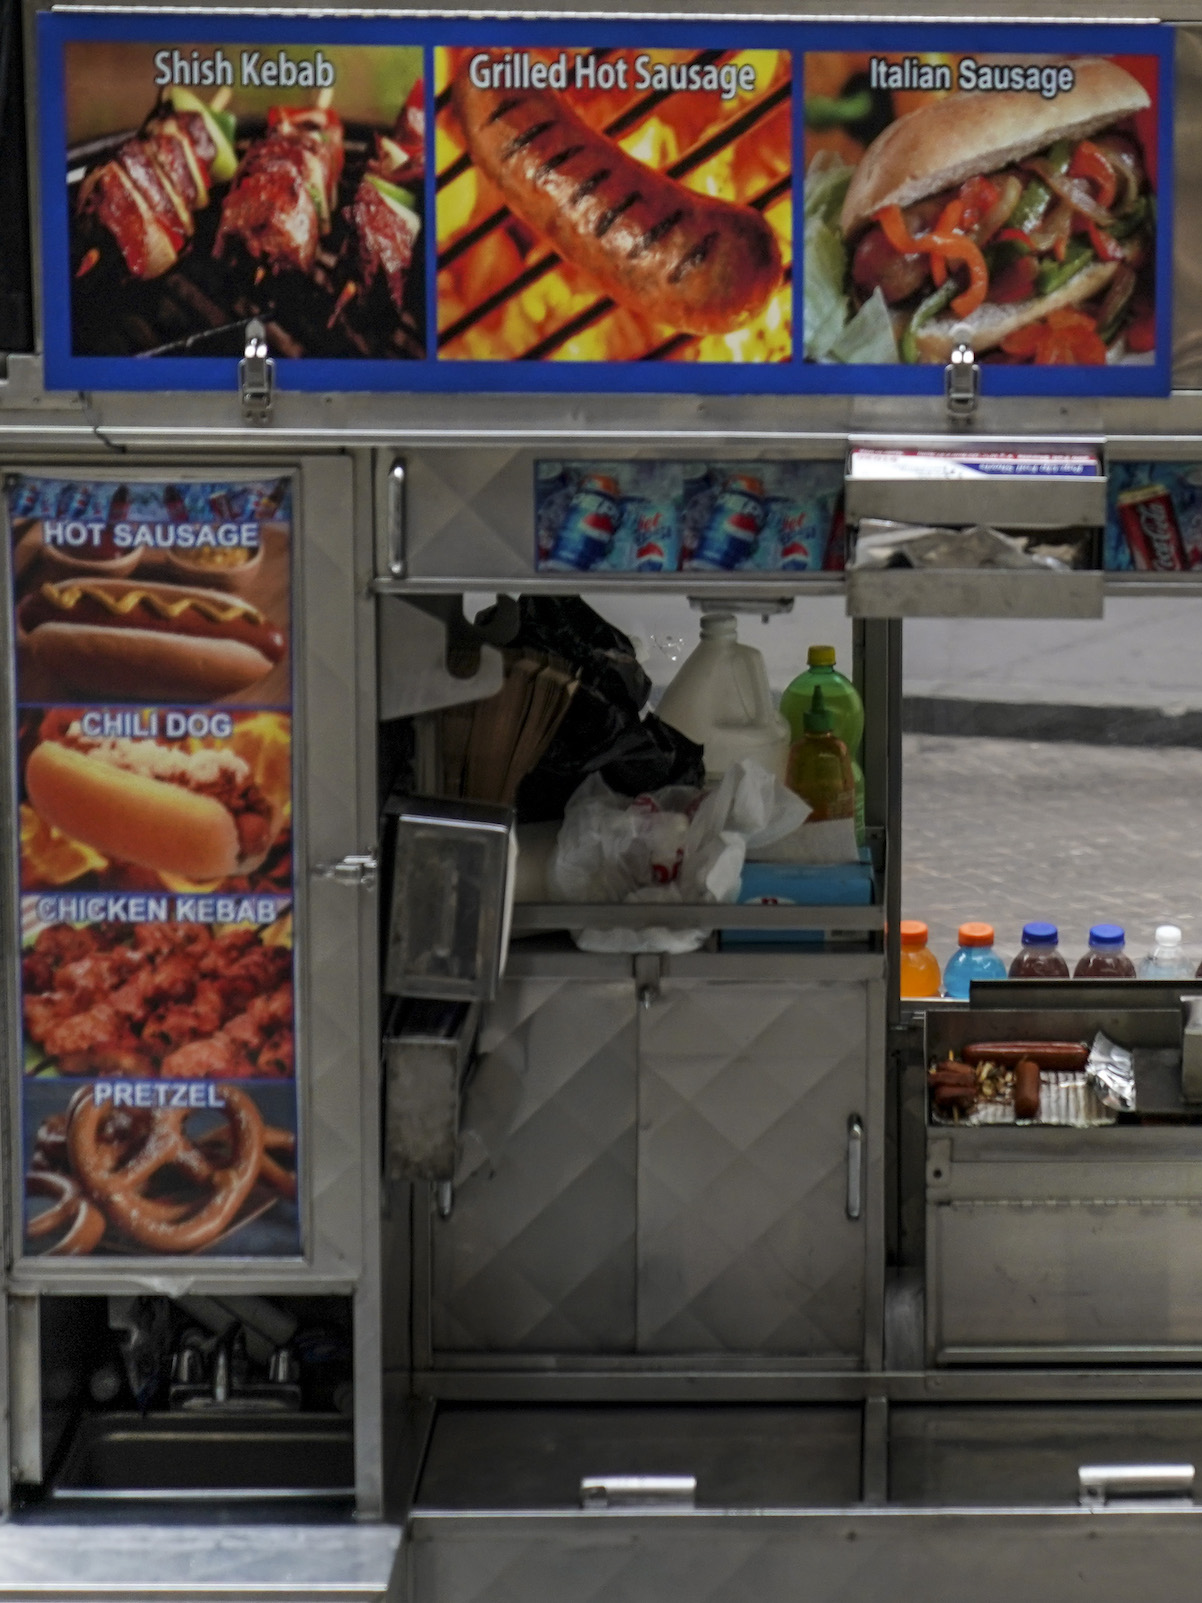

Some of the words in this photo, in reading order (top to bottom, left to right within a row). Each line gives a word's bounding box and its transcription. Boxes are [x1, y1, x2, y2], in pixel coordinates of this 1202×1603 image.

[154, 50, 233, 87] Shish
[241, 51, 336, 88] Kebab
[469, 53, 569, 91] Grilled
[575, 55, 629, 91] Hot
[634, 56, 757, 99] Sausage
[870, 58, 951, 91] Italian
[957, 59, 1075, 98] Sausage
[43, 521, 105, 548] HOT
[112, 521, 261, 548] SAUSAGE
[80, 711, 158, 739] CHILI
[165, 712, 234, 739] DOG
[36, 896, 169, 923] CHICKEN
[175, 896, 278, 924] KEBAB
[92, 1081, 227, 1109] PRETZEL
